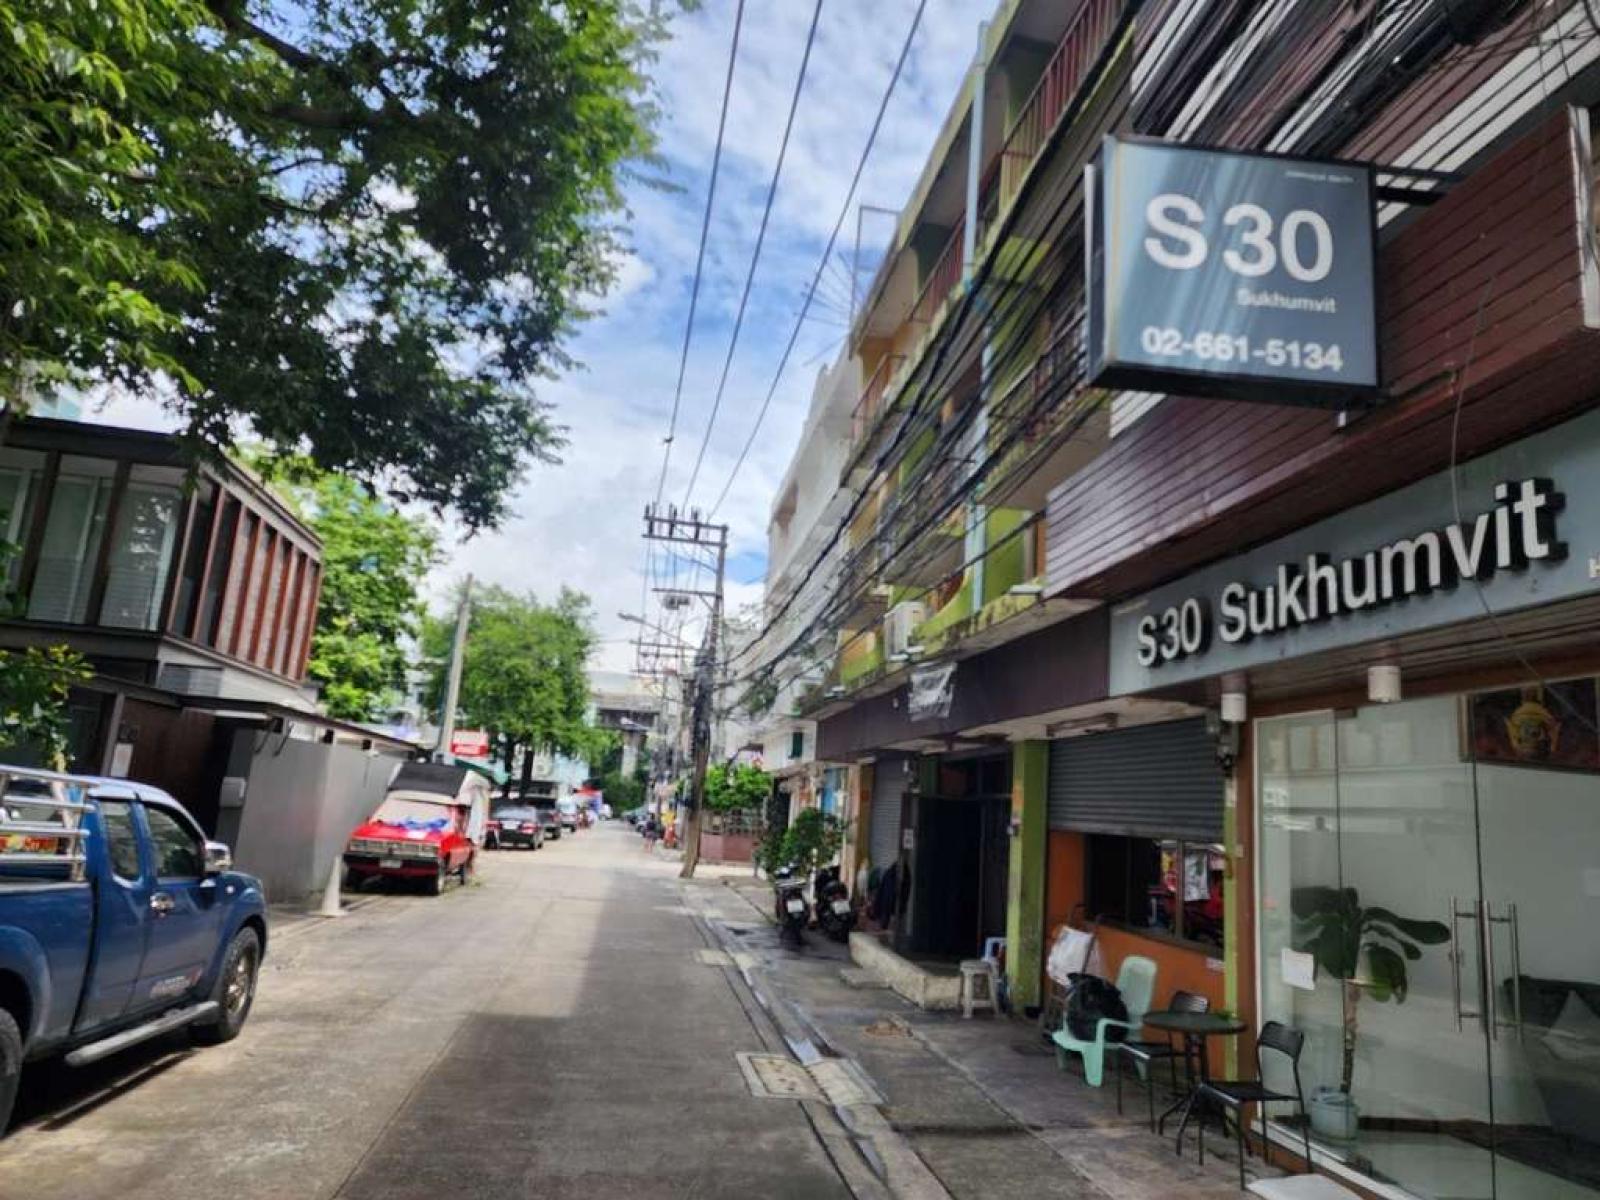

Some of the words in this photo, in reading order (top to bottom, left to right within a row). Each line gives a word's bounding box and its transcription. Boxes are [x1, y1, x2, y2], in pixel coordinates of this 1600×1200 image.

[1236, 288, 1337, 314] Sukhumvit
[1141, 326, 1343, 371] 02-661-5134
[1137, 598, 1201, 666] S30
[1219, 479, 1549, 643] Sukhumvit
